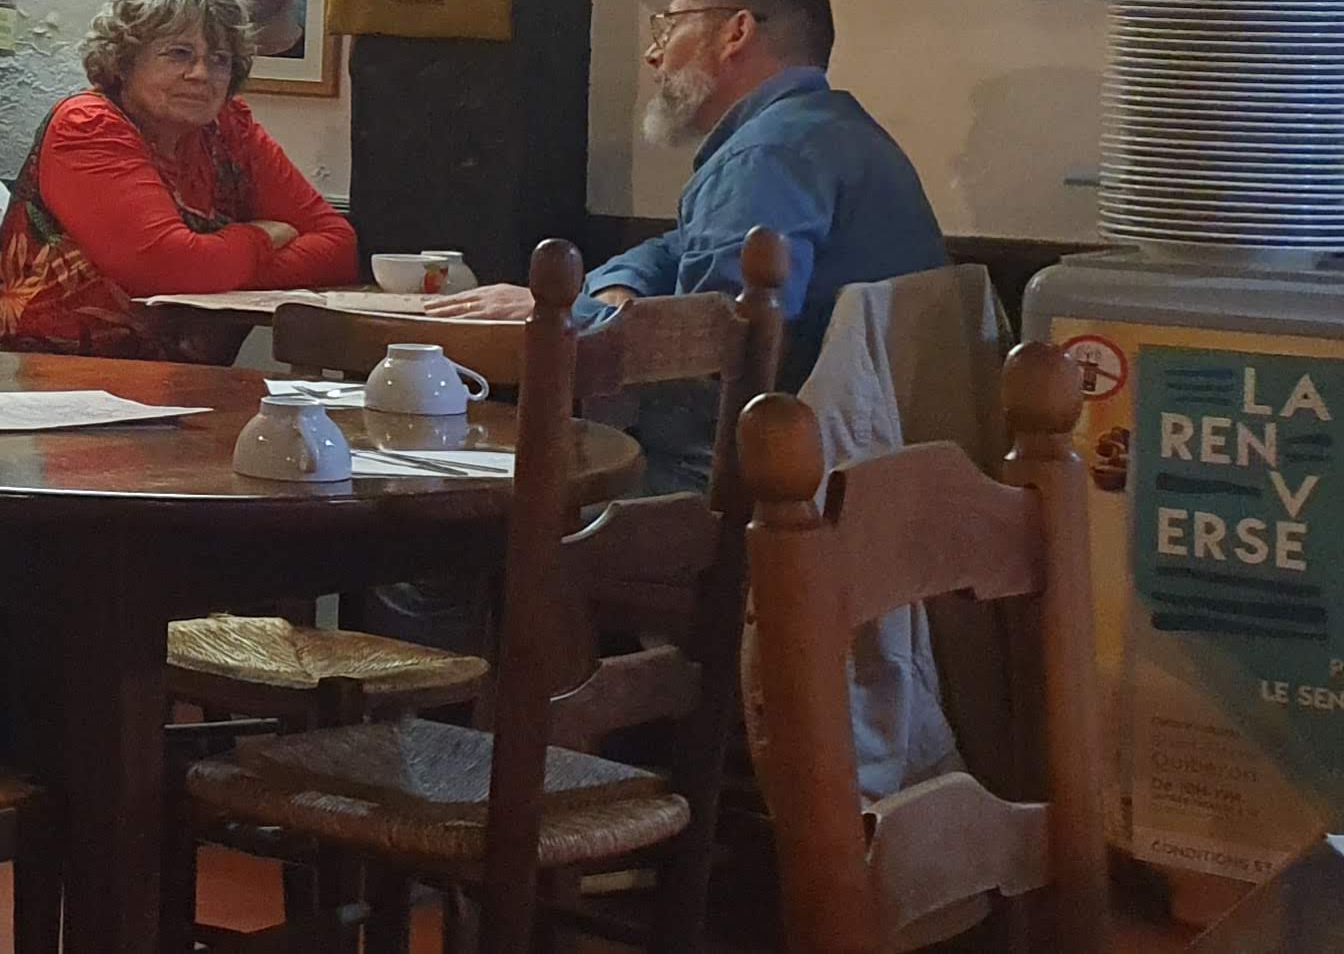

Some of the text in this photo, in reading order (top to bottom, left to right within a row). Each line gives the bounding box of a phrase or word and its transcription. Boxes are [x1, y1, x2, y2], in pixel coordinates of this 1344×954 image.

[1242, 366, 1332, 422] LA
[1160, 411, 1280, 470] REN
[1269, 470, 1321, 519] V
[1156, 506, 1308, 572] ERSE
[1259, 679, 1289, 705] LE
